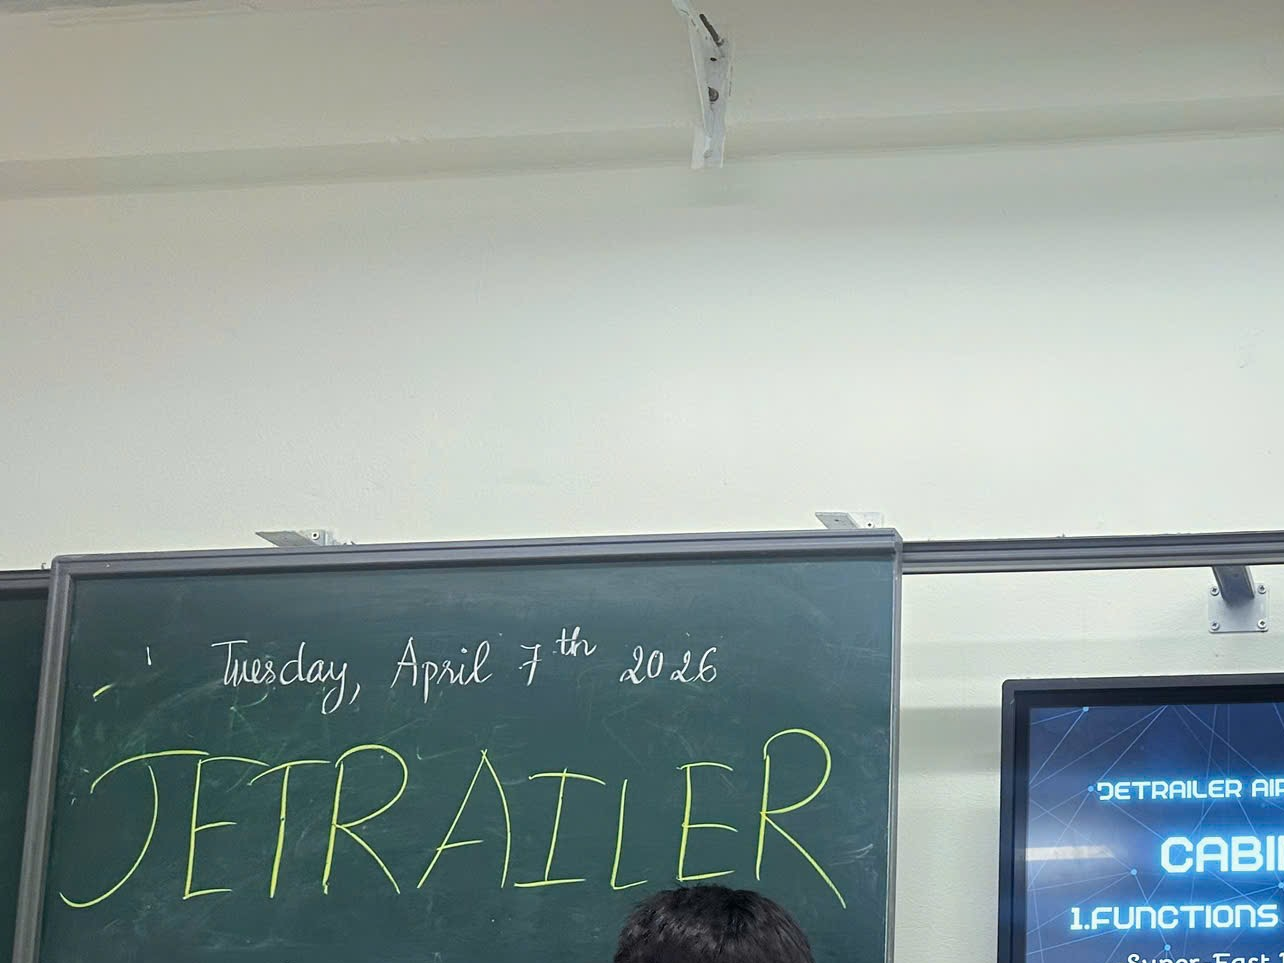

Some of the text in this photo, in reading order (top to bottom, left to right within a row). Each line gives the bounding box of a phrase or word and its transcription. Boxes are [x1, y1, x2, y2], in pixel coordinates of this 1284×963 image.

[212, 639, 361, 715] Tuesday,
[392, 636, 491, 706] April
[619, 644, 718, 686] 2026
[60, 728, 847, 909] JETRAILER
[1070, 904, 1278, 930] 1.FUNCTIONS
